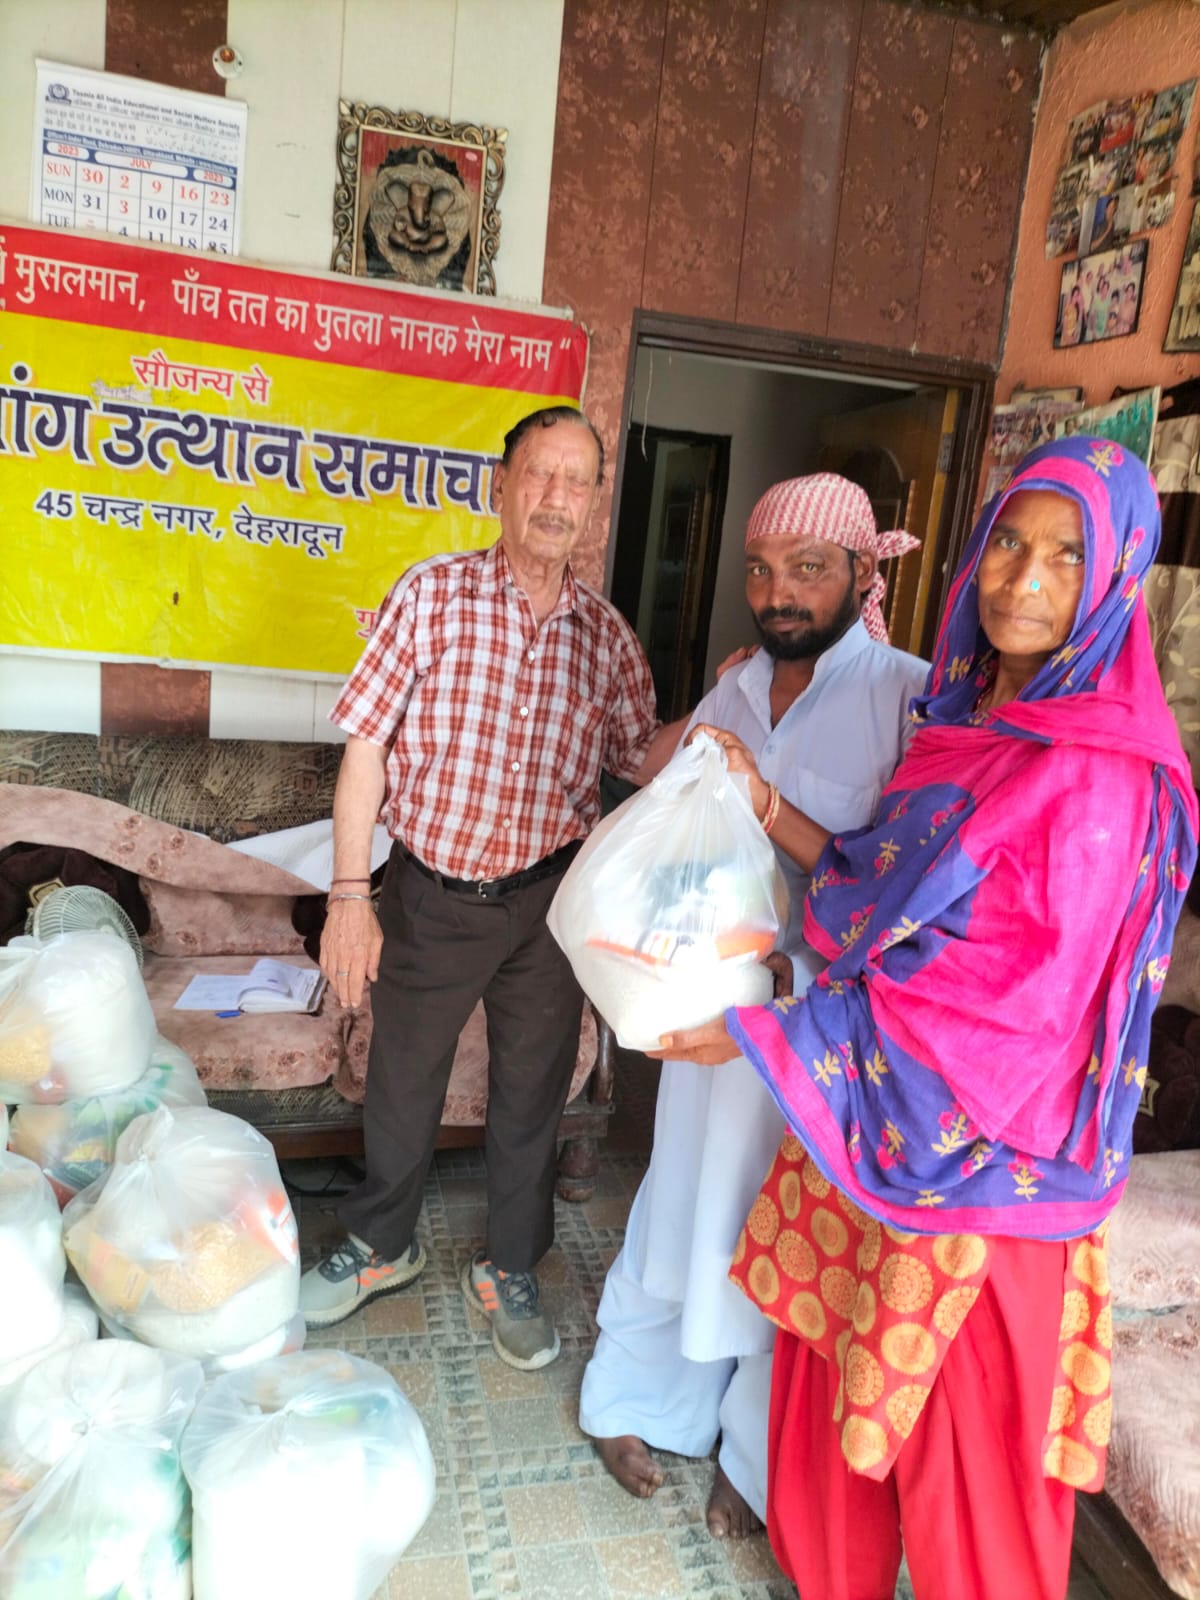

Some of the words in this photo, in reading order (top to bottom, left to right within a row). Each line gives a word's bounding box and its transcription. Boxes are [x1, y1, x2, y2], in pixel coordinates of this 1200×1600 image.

[106, 95, 122, 104] India
[123, 99, 160, 112] Educational
[174, 109, 193, 119] Social
[193, 114, 217, 125] Welfare
[218, 119, 241, 132] Society
[57, 143, 79, 157] 2023
[130, 157, 152, 169] JULY
[46, 161, 71, 177] SUN
[82, 167, 104, 184] 30
[120, 174, 129, 189] 2
[152, 180, 162, 193] 9
[180, 185, 198, 201] 16
[209, 191, 229, 206] 23
[203, 170, 224, 184] 2023
[44, 187, 73, 204] MON
[82, 193, 101, 210] 31
[119, 199, 129, 214] 3
[148, 206, 167, 221] 10
[179, 211, 198, 226] 17
[208, 215, 228, 232] 24
[14, 252, 145, 312] मुसलमान,
[172, 266, 221, 319] पाँच
[228, 289, 268, 327] तत
[275, 297, 308, 334] का
[315, 303, 384, 351] पुतला
[390, 316, 457, 356] नानक
[464, 316, 505, 365] मेरा
[510, 336, 552, 371] नाम
[132, 350, 235, 397] सौजन्य
[242, 366, 270, 402] से
[0, 364, 93, 462] ांग
[36, 491, 73, 518] 45
[82, 496, 143, 528] चन्द्र
[151, 504, 223, 539] नगर,
[235, 505, 343, 557] देहरादून
